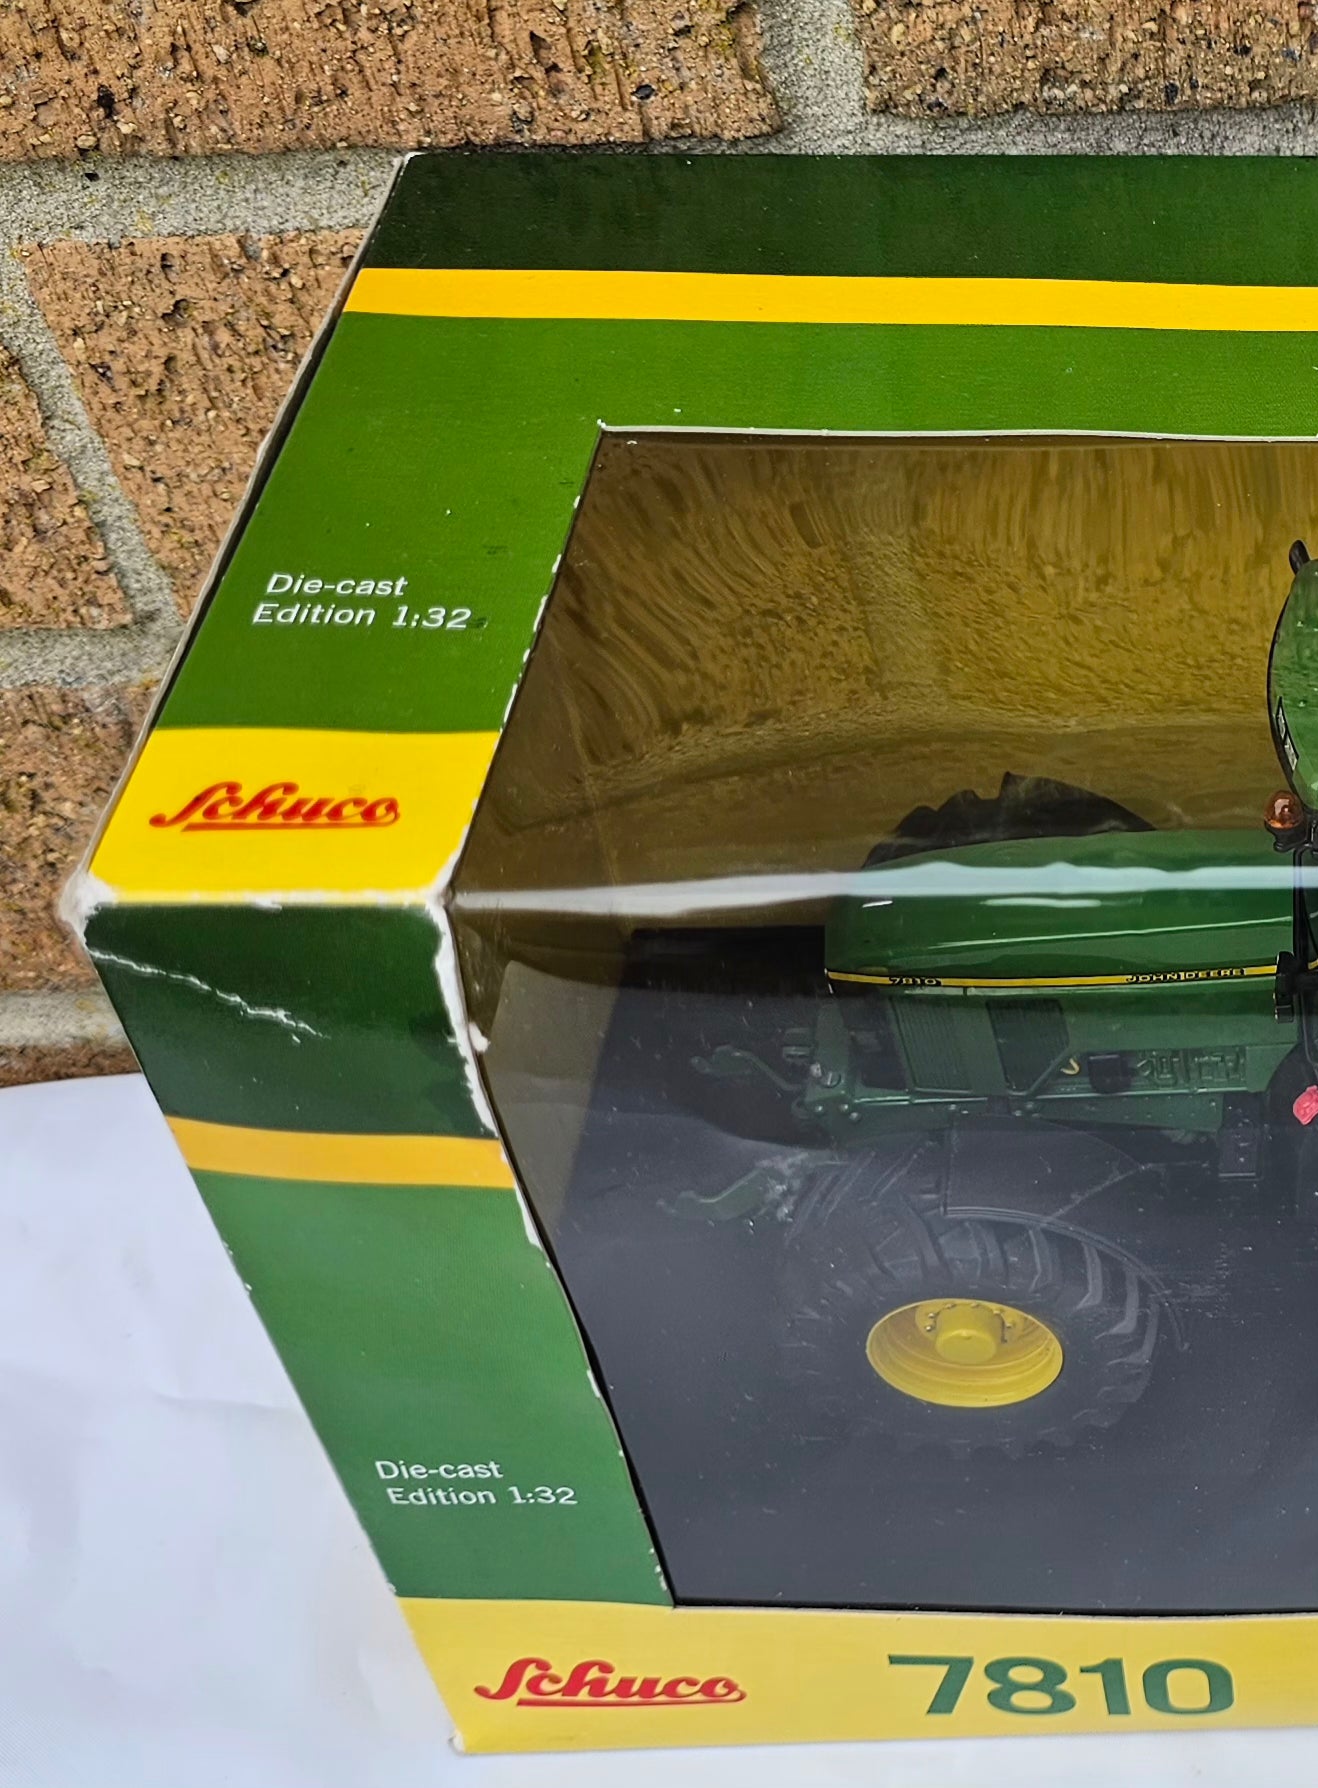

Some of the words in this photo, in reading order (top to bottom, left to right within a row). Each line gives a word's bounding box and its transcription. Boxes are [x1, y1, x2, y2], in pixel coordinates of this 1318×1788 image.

[265, 572, 408, 597] Die-cast
[251, 603, 376, 626] Edition
[392, 605, 472, 630] 1:32
[148, 781, 400, 832] Schuco
[1126, 972, 1178, 983] JOHN
[1185, 967, 1243, 979] DEERE
[374, 1459, 504, 1480] Die-cast
[386, 1486, 497, 1506] Edition
[507, 1485, 579, 1506] 1:32
[473, 1656, 747, 1707] Schuco
[888, 1653, 1236, 1716] 7810
